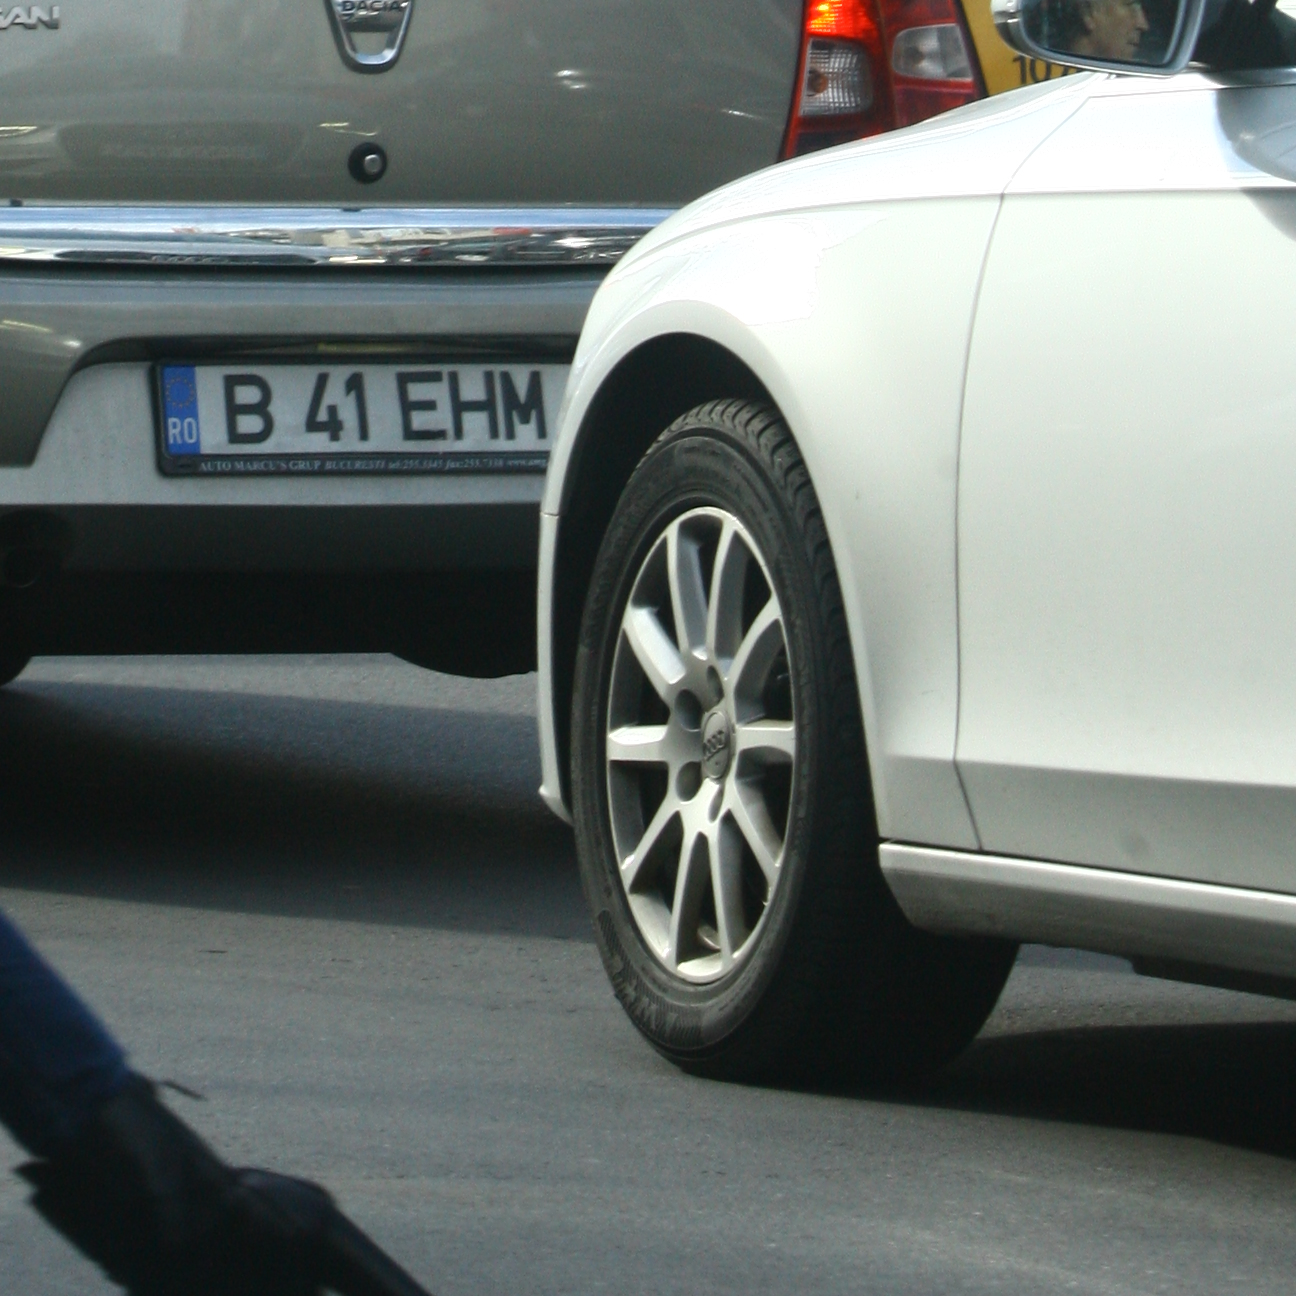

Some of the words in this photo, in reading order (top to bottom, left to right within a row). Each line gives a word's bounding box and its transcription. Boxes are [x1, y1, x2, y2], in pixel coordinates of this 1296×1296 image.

[342, 0, 405, 11] DACIA
[223, 374, 274, 445] B
[304, 371, 369, 442] 41
[395, 370, 548, 442] EHM
[168, 416, 198, 445] RO
[198, 460, 232, 472] AUTO
[288, 459, 322, 470] GRUP
